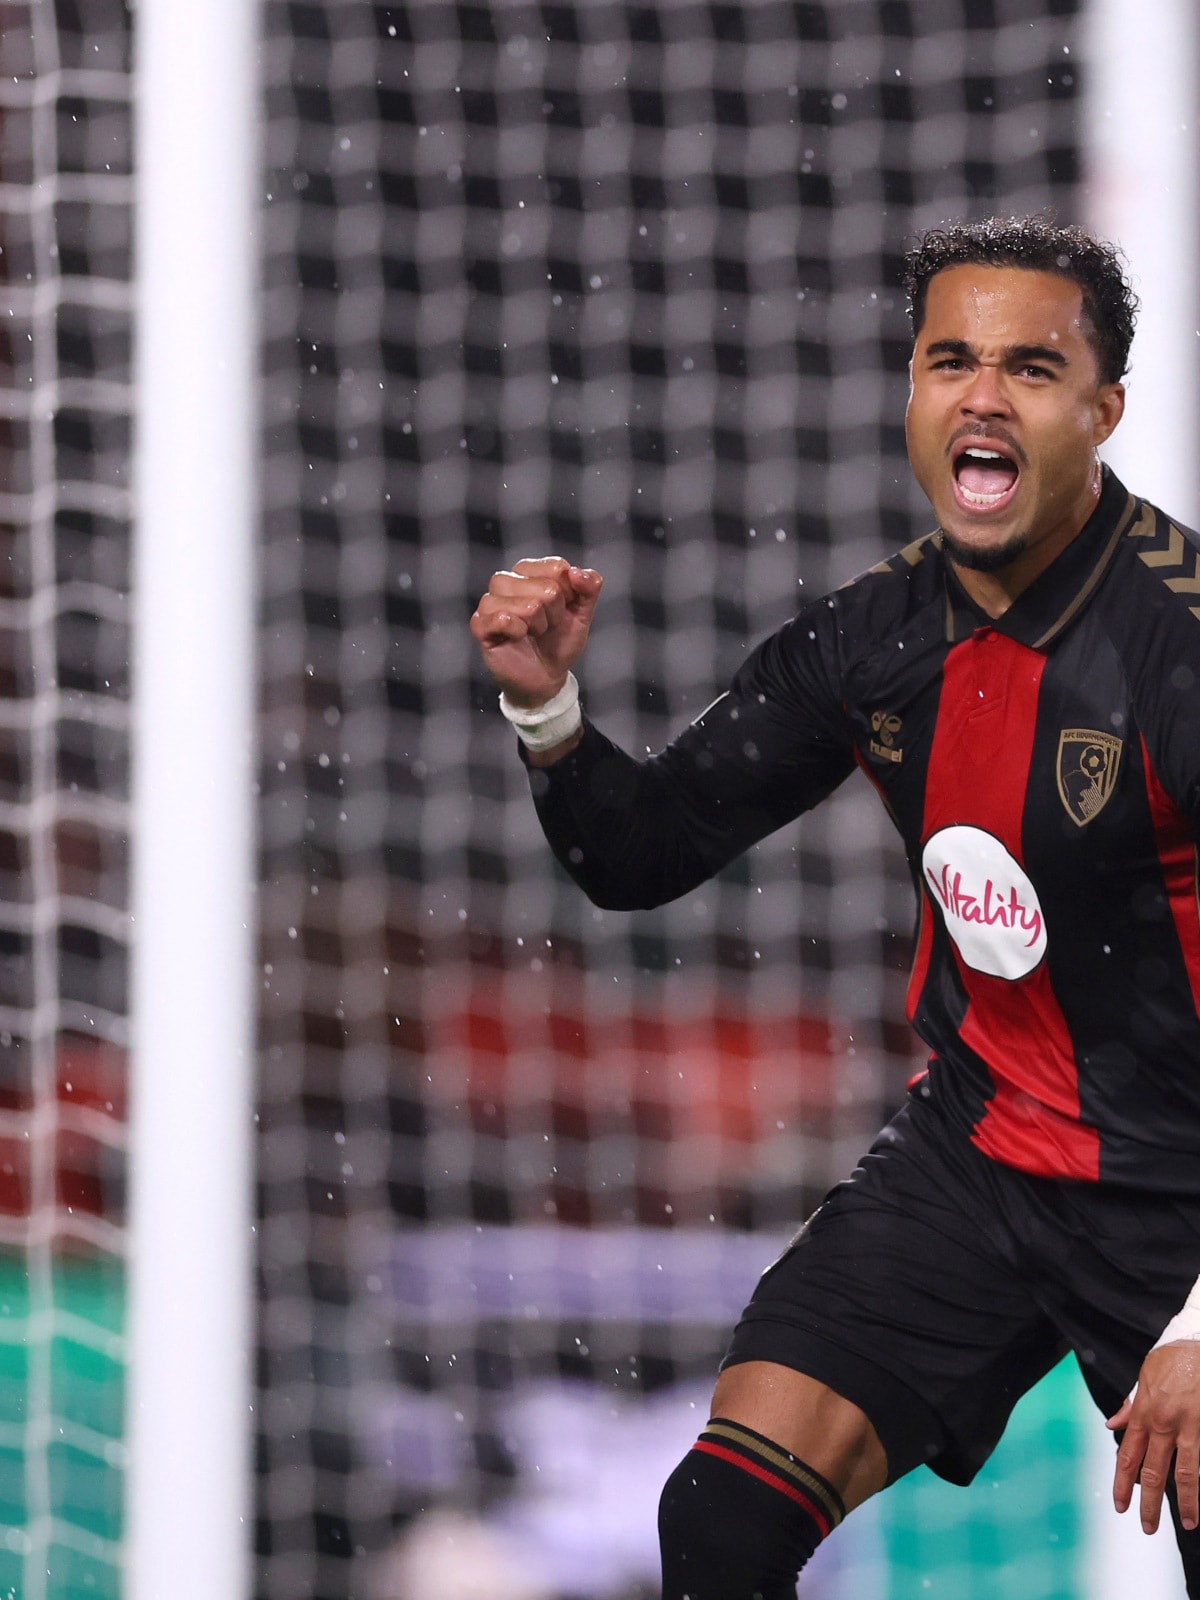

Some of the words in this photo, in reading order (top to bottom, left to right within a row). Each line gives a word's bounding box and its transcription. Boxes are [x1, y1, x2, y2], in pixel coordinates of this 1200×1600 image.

[1063, 731, 1075, 739] AFC
[1076, 731, 1120, 748] BOURNEMOUTH
[927, 864, 1041, 948] Vitality
